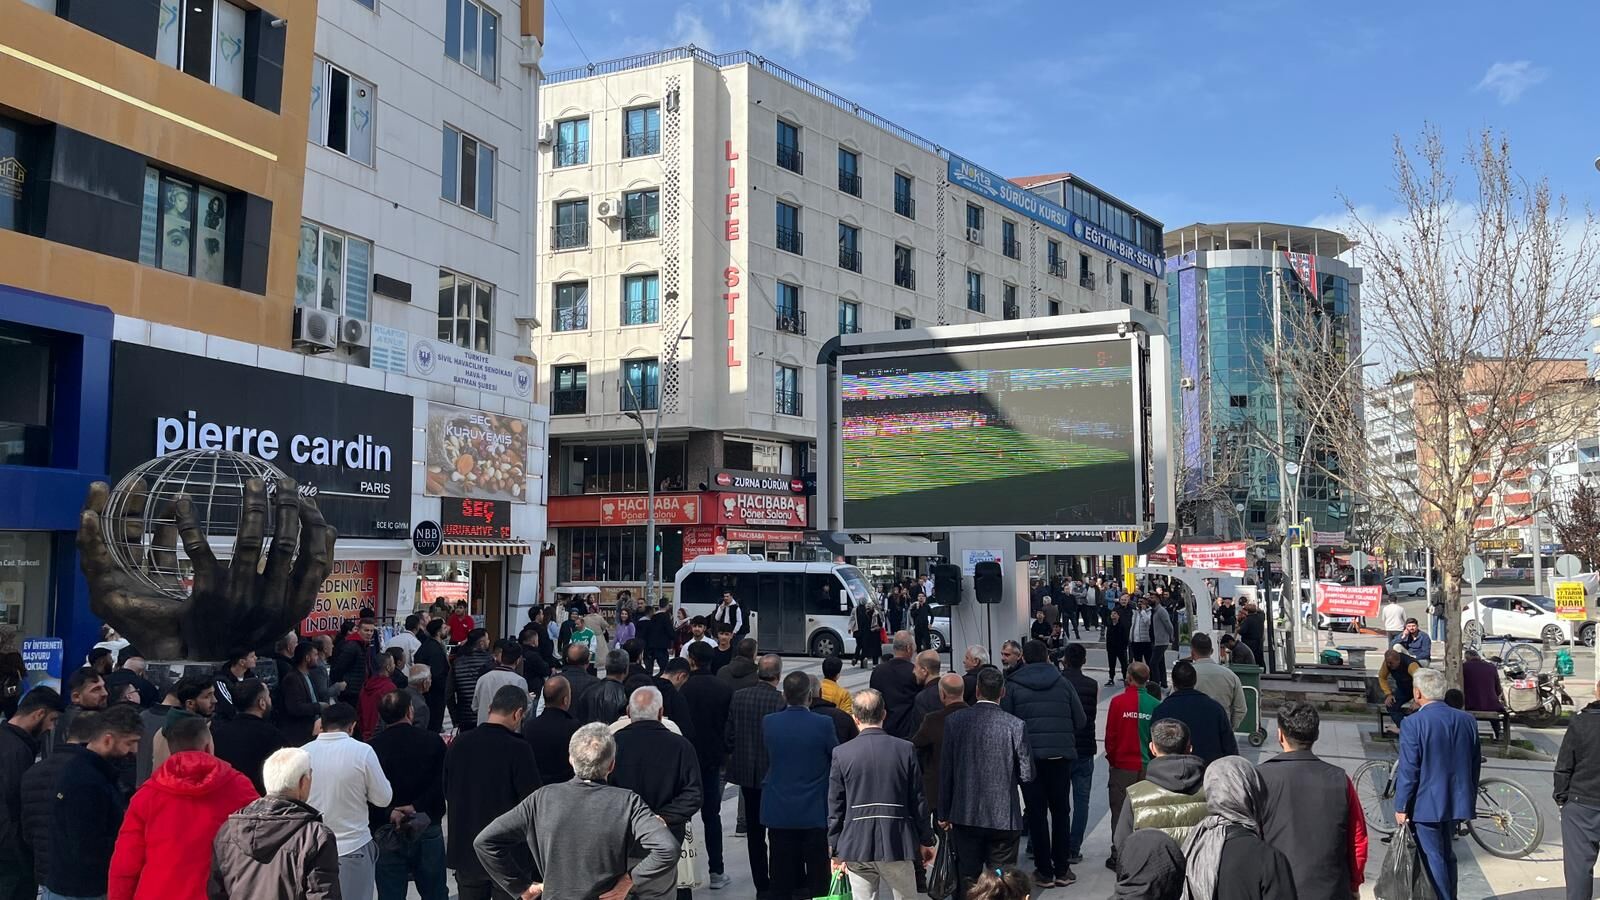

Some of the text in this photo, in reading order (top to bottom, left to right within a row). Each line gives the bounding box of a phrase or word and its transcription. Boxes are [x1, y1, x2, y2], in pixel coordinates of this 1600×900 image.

[961, 162, 991, 186] Nokta
[999, 184, 1037, 214] SÜRÜCÜ
[1038, 204, 1068, 228] KURSU
[723, 140, 741, 367] LIFE STIL
[437, 353, 513, 377] SİVİL HAVACILIK SENDİKASI
[464, 352, 489, 364] TÜRKİYE
[465, 370, 487, 381] HAVA-İŞ
[453, 376, 498, 391] BATMAN ŞUBESİ
[469, 414, 491, 429] SEÇ
[156, 410, 392, 472] pierre cardin
[446, 426, 512, 447] KURUYEMİŞ
[360, 482, 391, 494] PARIS
[734, 477, 760, 488] ZURNA
[761, 478, 789, 491] DÜRÜM
[737, 494, 795, 511] HACIBABA
[463, 498, 494, 524] SEÇ
[653, 510, 677, 519] alonu
[740, 508, 792, 520] Döner Salonu
[377, 521, 387, 529] ECE
[443, 525, 493, 537] URUKAHVE
[416, 528, 438, 539] NBB
[318, 578, 375, 594] EDENİYLE
[311, 596, 376, 613] 50 VARAN
[23, 640, 63, 650] EV İNTERNETİ
[23, 651, 51, 661] BAŞVURU
